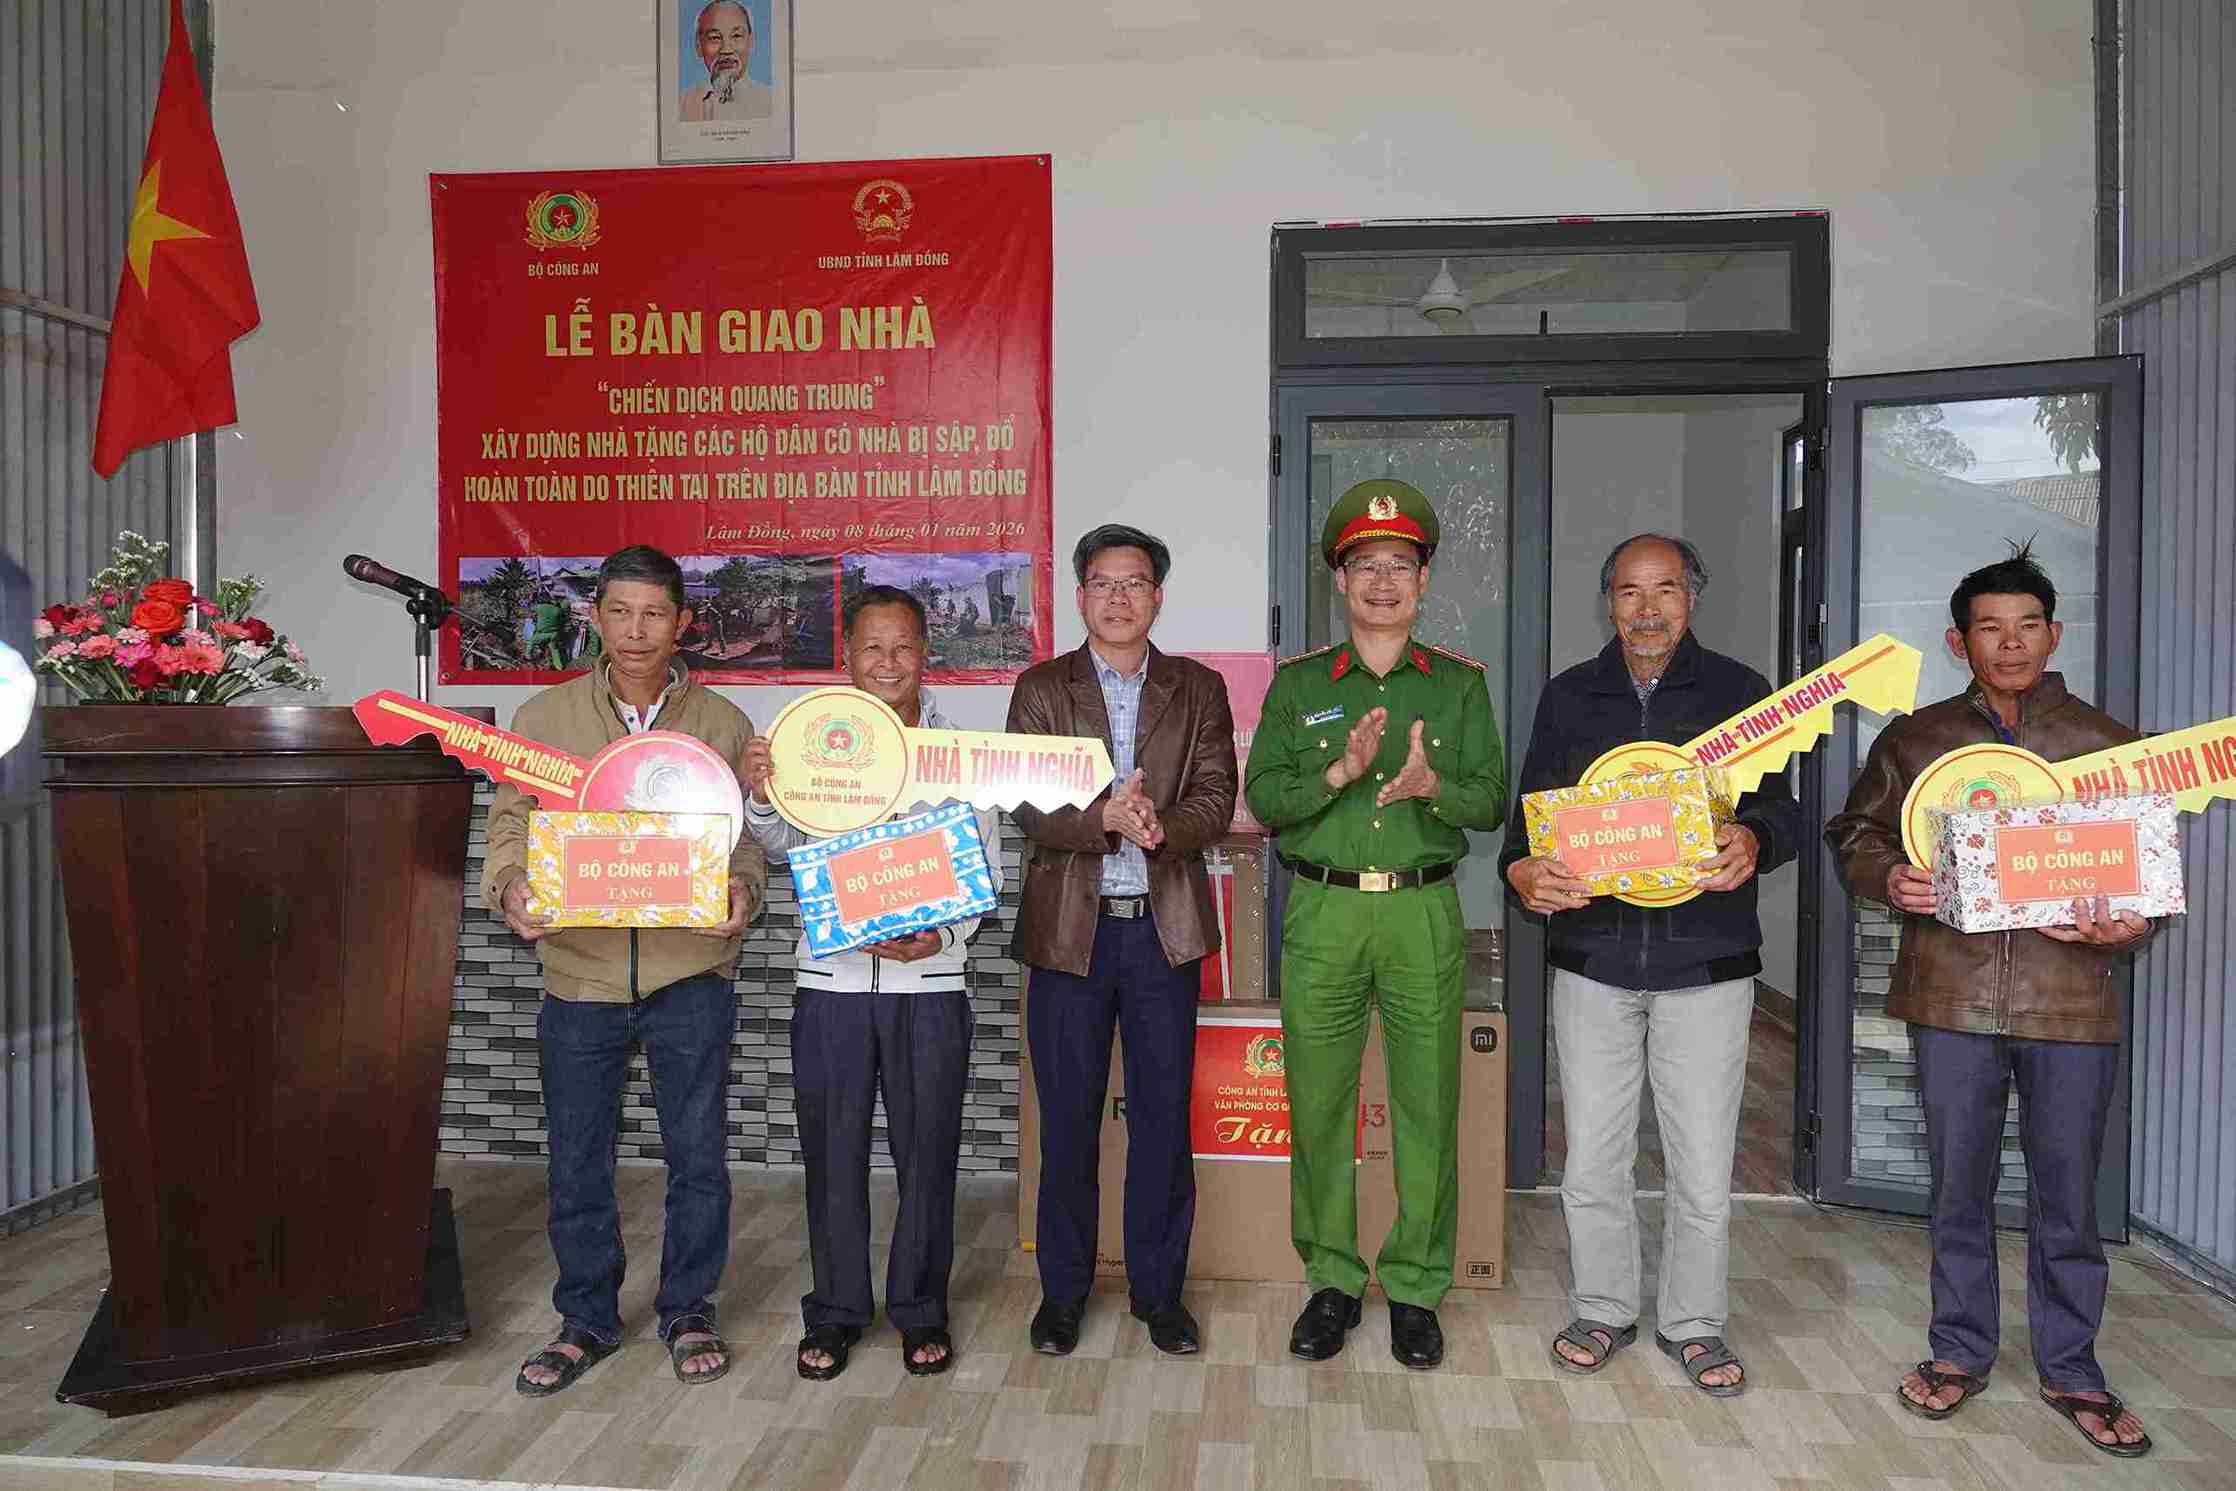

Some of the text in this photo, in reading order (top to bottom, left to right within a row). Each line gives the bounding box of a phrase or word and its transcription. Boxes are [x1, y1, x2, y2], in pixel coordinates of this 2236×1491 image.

[528, 261, 600, 278] BỘ CÔNG AN
[818, 250, 949, 269] UBND TỈNH LÂM ĐỒNG
[545, 297, 936, 356] LỄ BÀN GIAO NHÀ
[676, 386, 724, 419] DỊCH
[730, 385, 799, 414] QUANG
[481, 414, 1015, 464] XÂY DỰNG NHÀ TẶNG CÁC HỘ DÂN CÓ NHÀ BỊ SẬP, ĐỔ
[464, 460, 1027, 504] HOÀN TOÀN DO THIÊN TAI TRÊN ĐỊA BÀN TỈNH LÂM ĐỒNG
[706, 520, 1026, 541] Lâm Đồng, ngày 08 tháng 01 năm 2026
[1695, 671, 1848, 768] NHÀ TÌNH NGHĨA
[444, 720, 577, 786] NHÀ TÌNH NGHĨA
[915, 739, 1096, 794] NHÀ TÌNH NGHĨA
[2071, 757, 2129, 801] NHÀ
[2131, 747, 2202, 796] TÌNH
[1567, 822, 1664, 851] BỘ CÔNG AN
[578, 857, 680, 880] BỘ CÔNG AN
[845, 856, 940, 893] BỘ CÔNG AN
[2011, 847, 2125, 874] BỘ CÔNG AN
[1245, 1087, 1258, 1097] AN
